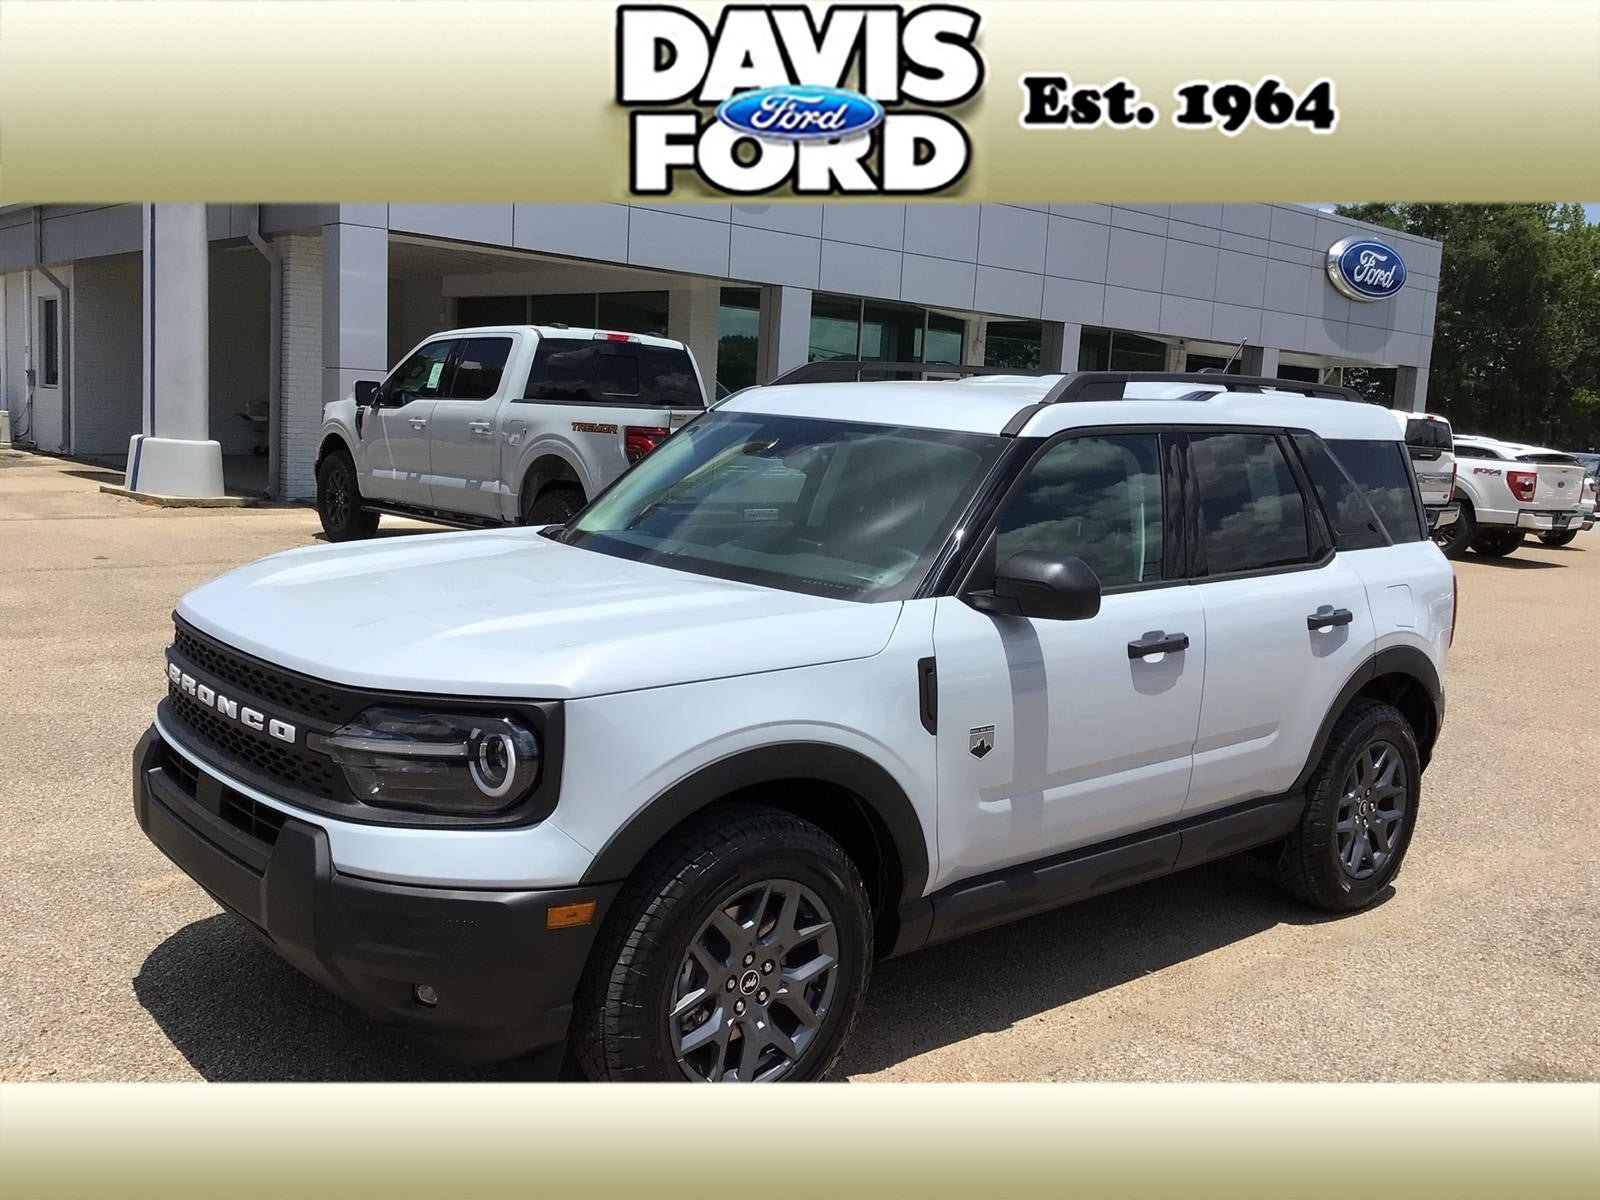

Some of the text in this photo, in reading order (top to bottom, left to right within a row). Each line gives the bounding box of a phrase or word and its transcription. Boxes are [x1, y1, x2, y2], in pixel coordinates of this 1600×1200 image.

[1354, 250, 1397, 288] Ford
[571, 422, 618, 434] TREMOR
[168, 662, 296, 744] BRONCO
